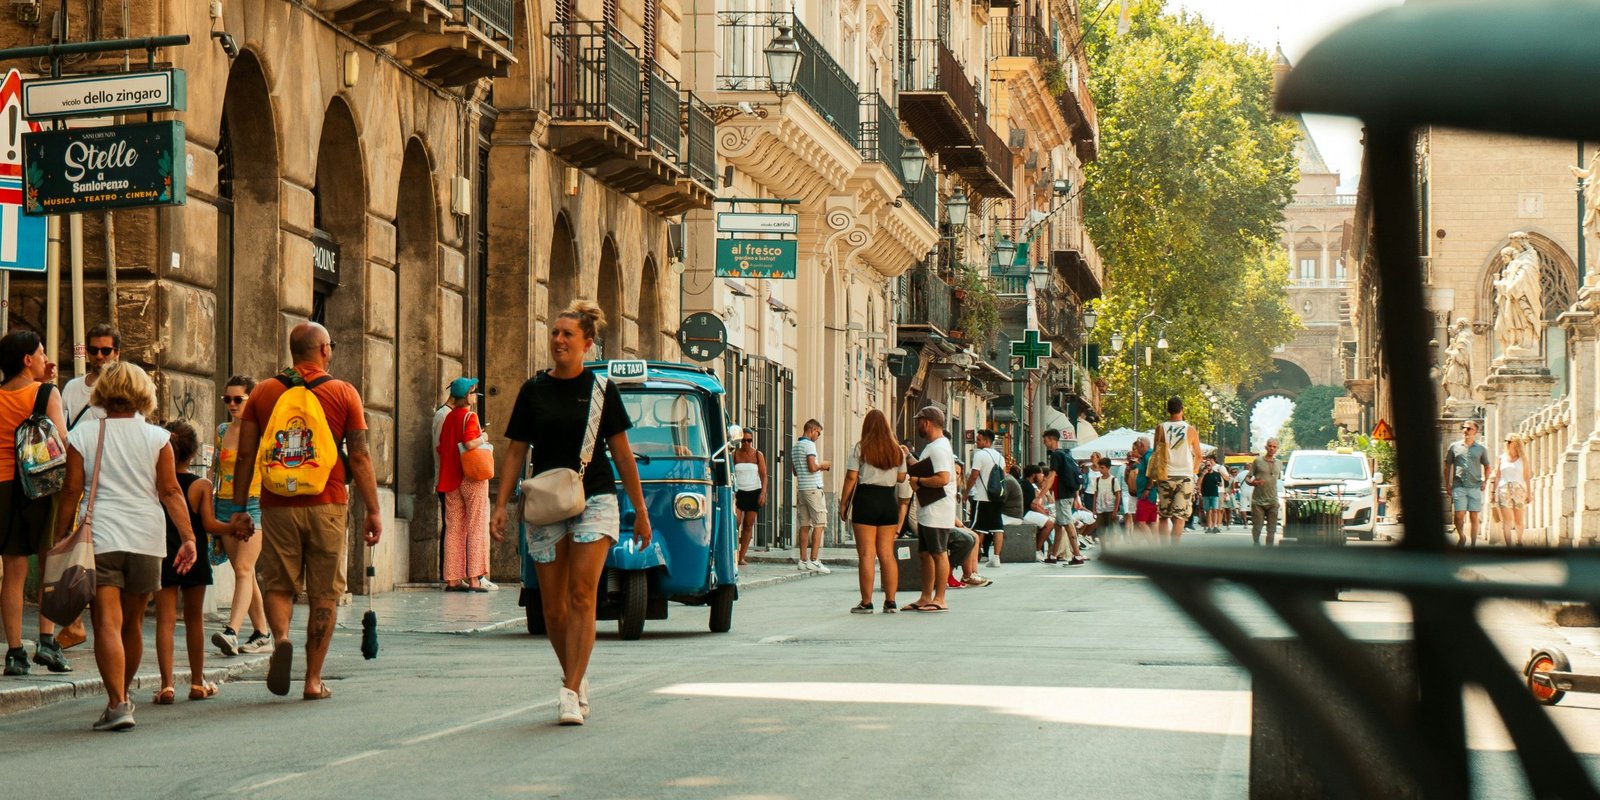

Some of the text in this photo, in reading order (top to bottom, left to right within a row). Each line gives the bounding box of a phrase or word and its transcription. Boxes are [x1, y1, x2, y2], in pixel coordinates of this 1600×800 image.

[62, 88, 162, 107] vicolo dello zingaro
[64, 139, 138, 182] Stelle
[97, 171, 104, 180] a
[72, 180, 129, 193] Sanlorenzo
[43, 197, 76, 206] MUSICA
[84, 193, 117, 202] TEATRO
[125, 190, 159, 200] CINEMA
[731, 243, 782, 256] al fresco
[613, 364, 642, 374] APE TAXI
